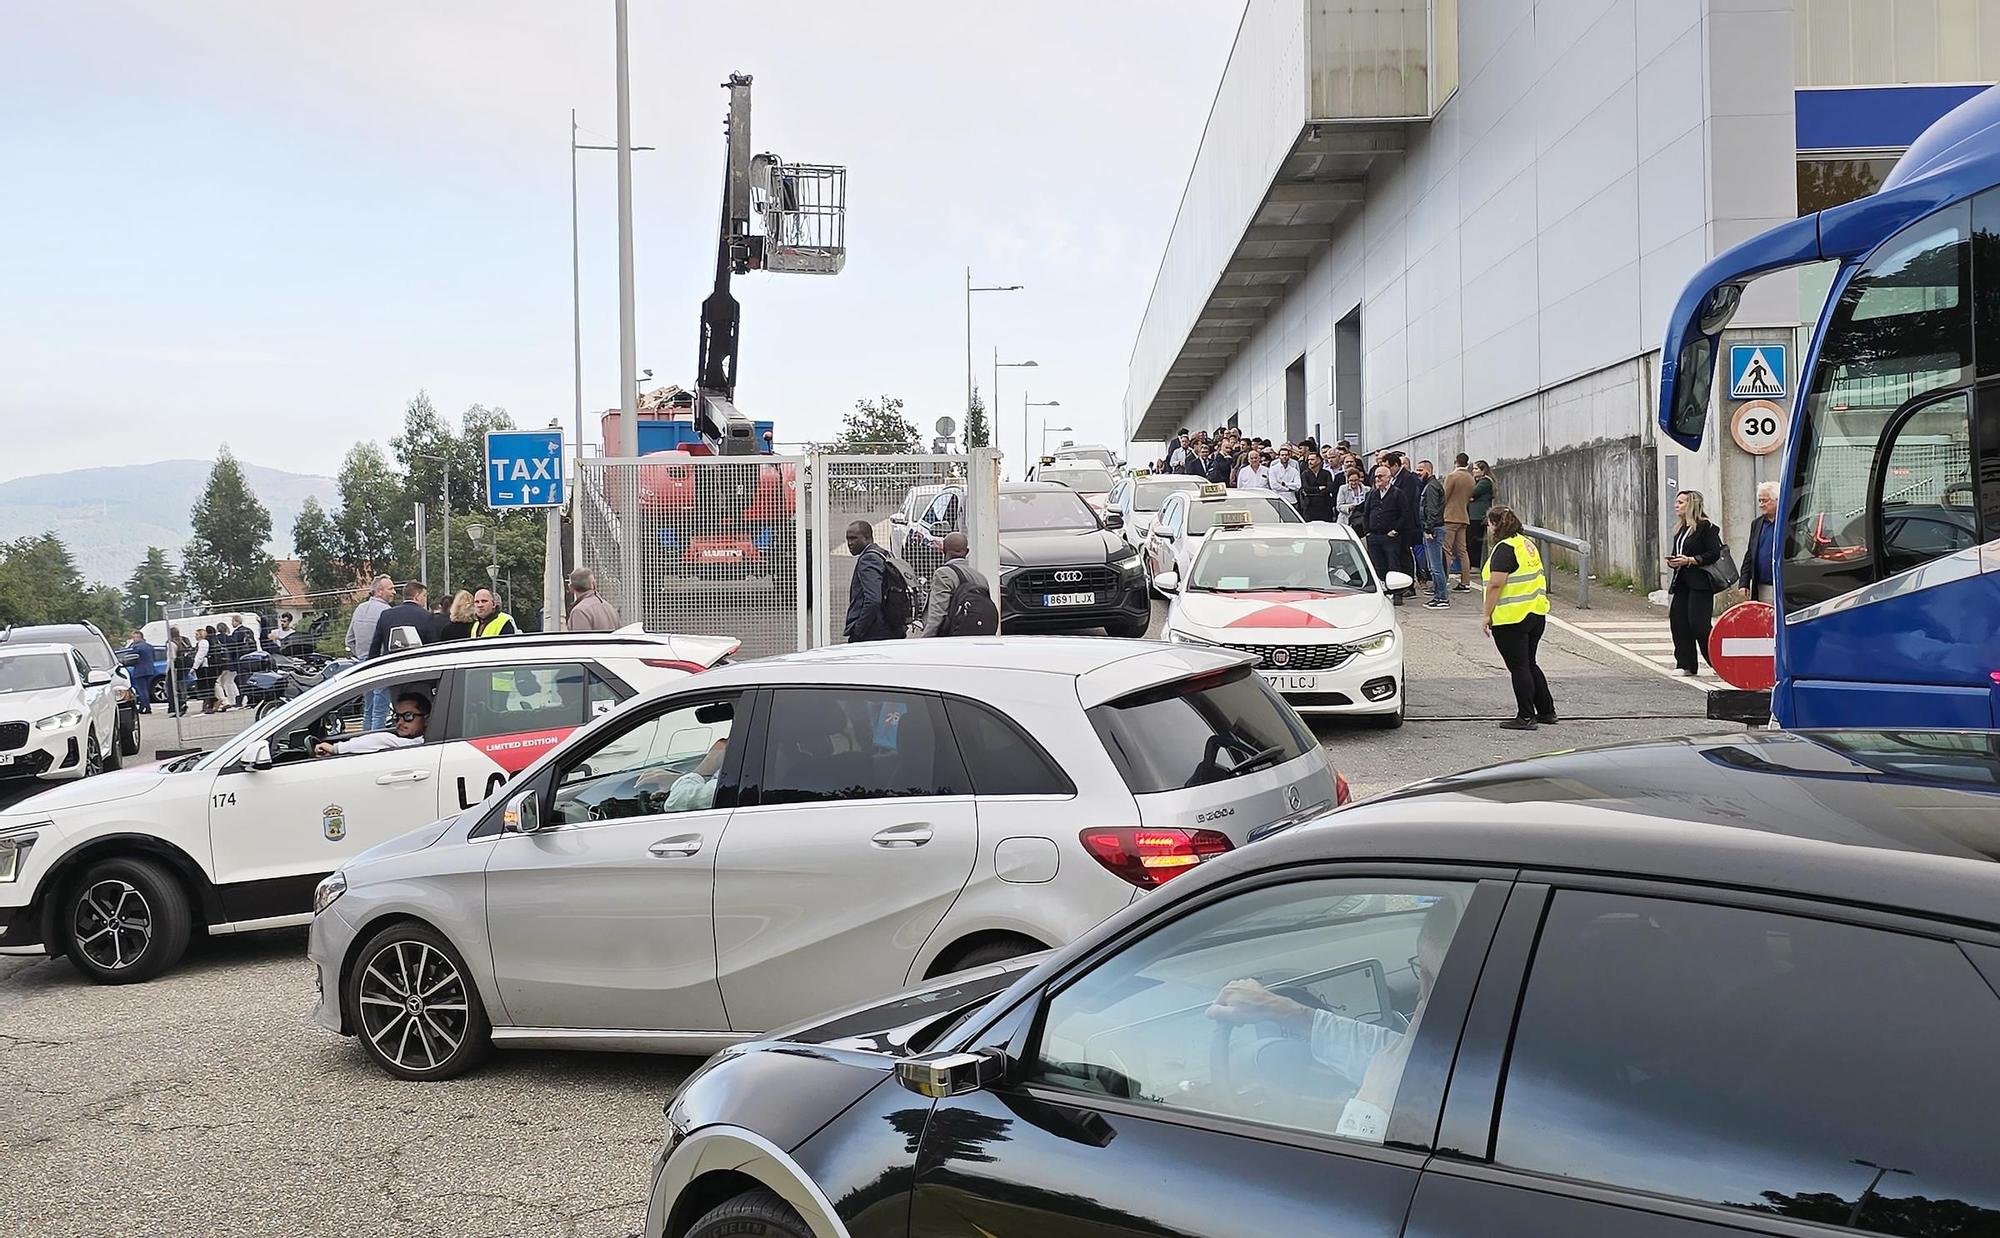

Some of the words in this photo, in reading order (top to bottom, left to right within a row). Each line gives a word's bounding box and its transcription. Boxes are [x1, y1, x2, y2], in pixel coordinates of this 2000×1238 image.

[1745, 418, 1776, 435] 30
[491, 457, 560, 481] TAXI
[1050, 595, 1073, 604] 8691
[1075, 594, 1093, 603] LJX
[1290, 676, 1315, 688] LCJ
[486, 742, 521, 751] LIMITED
[522, 737, 558, 748] EDITION
[212, 792, 236, 808] 174
